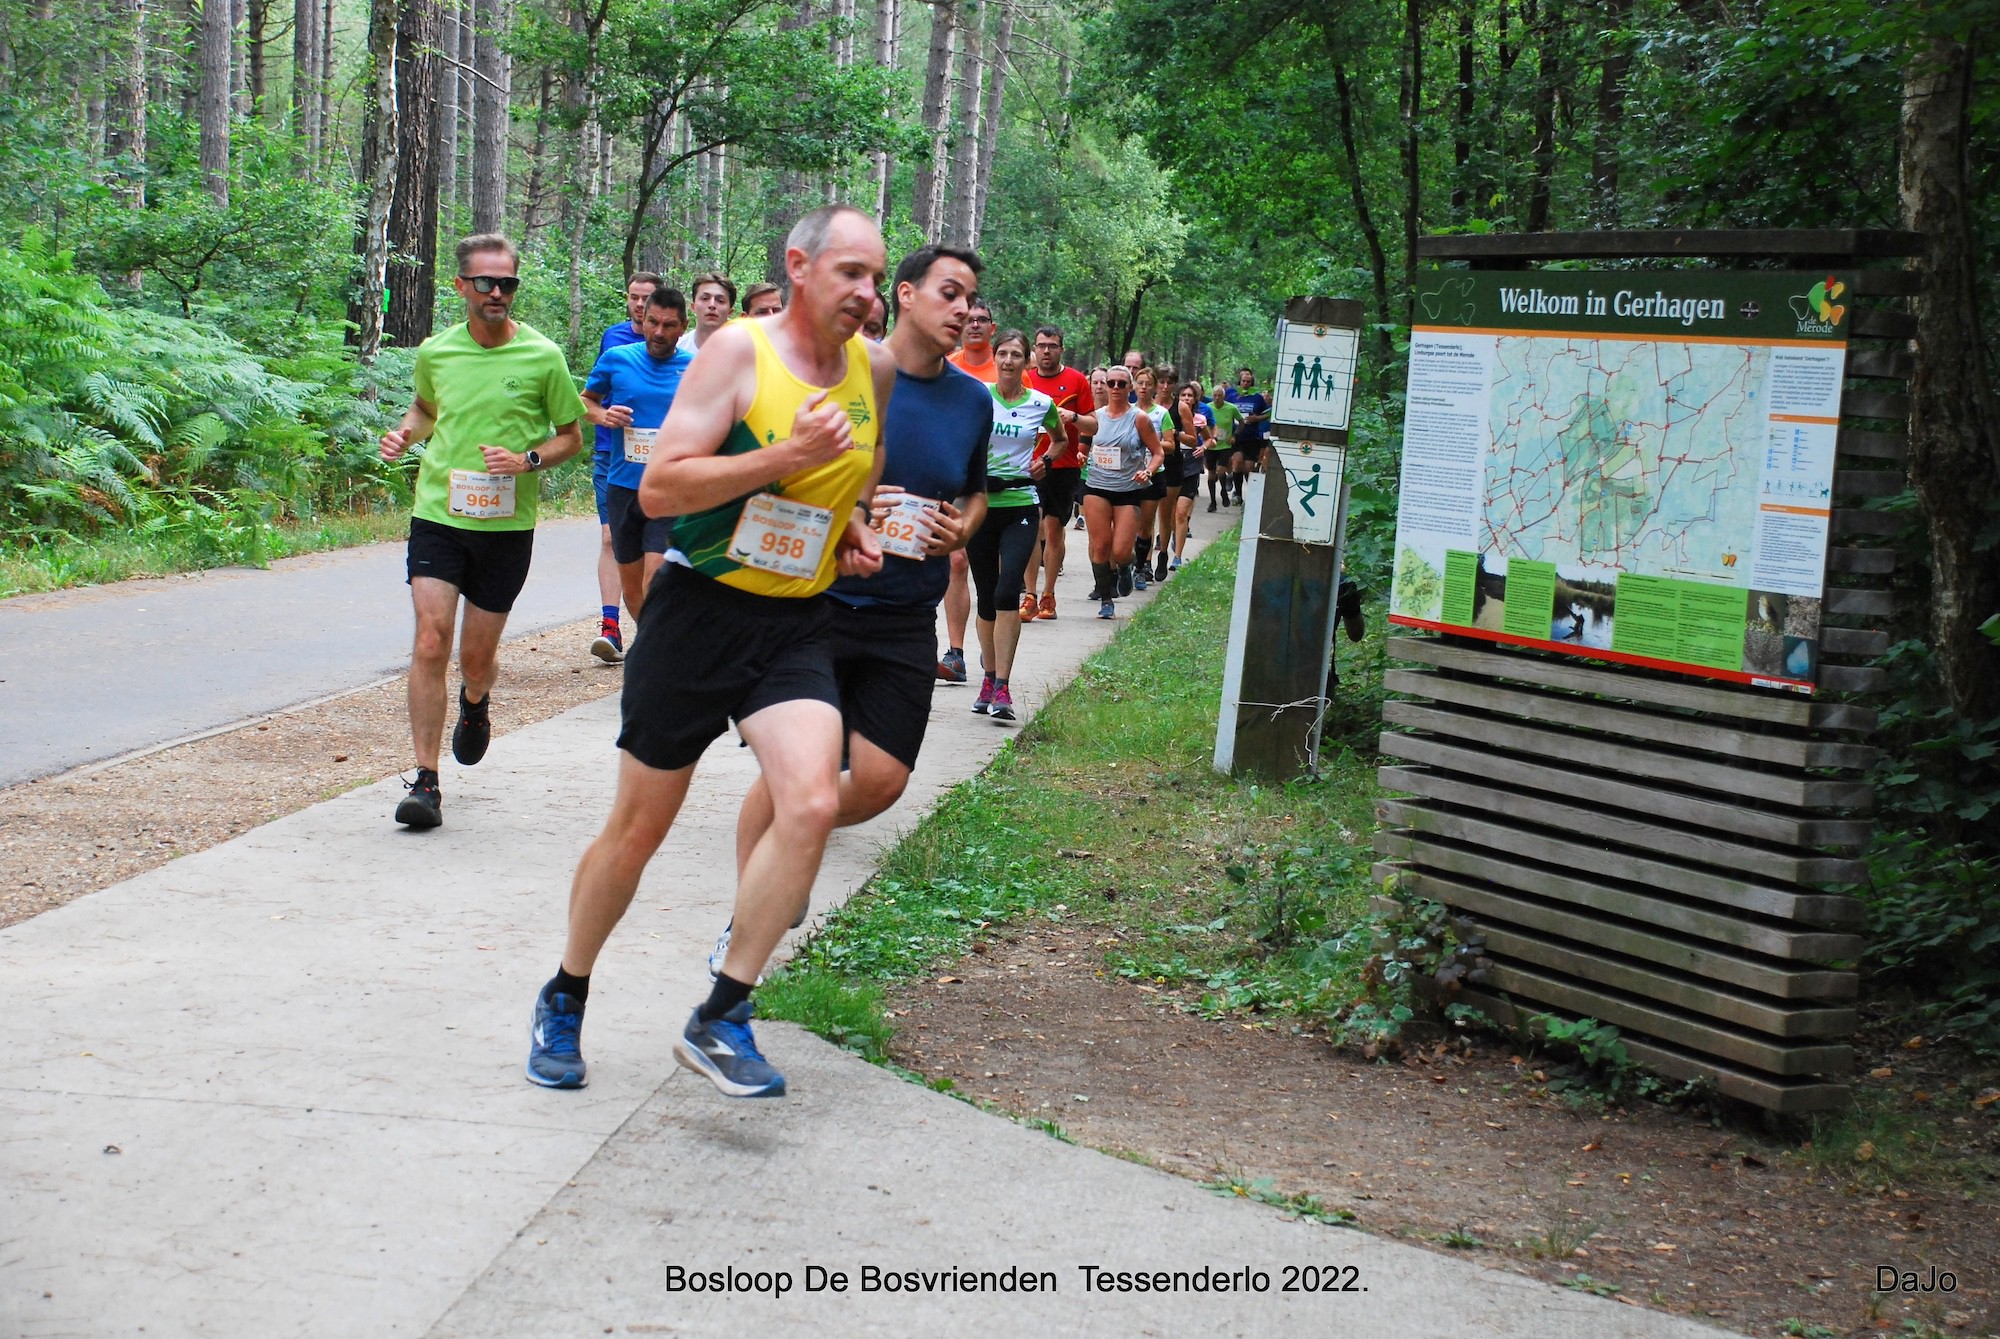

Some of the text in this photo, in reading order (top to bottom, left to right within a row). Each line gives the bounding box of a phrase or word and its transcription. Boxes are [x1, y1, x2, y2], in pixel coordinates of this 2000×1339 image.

[1500, 288, 1725, 326] Welkom in Gerhagen
[1796, 320, 1833, 333] Merode
[634, 444, 655, 455] 85
[1098, 457, 1113, 465] 826
[456, 483, 491, 492] BOSLOOP
[466, 493, 501, 508] 964
[752, 514, 796, 531] BOSLOOP
[760, 532, 805, 559] 958
